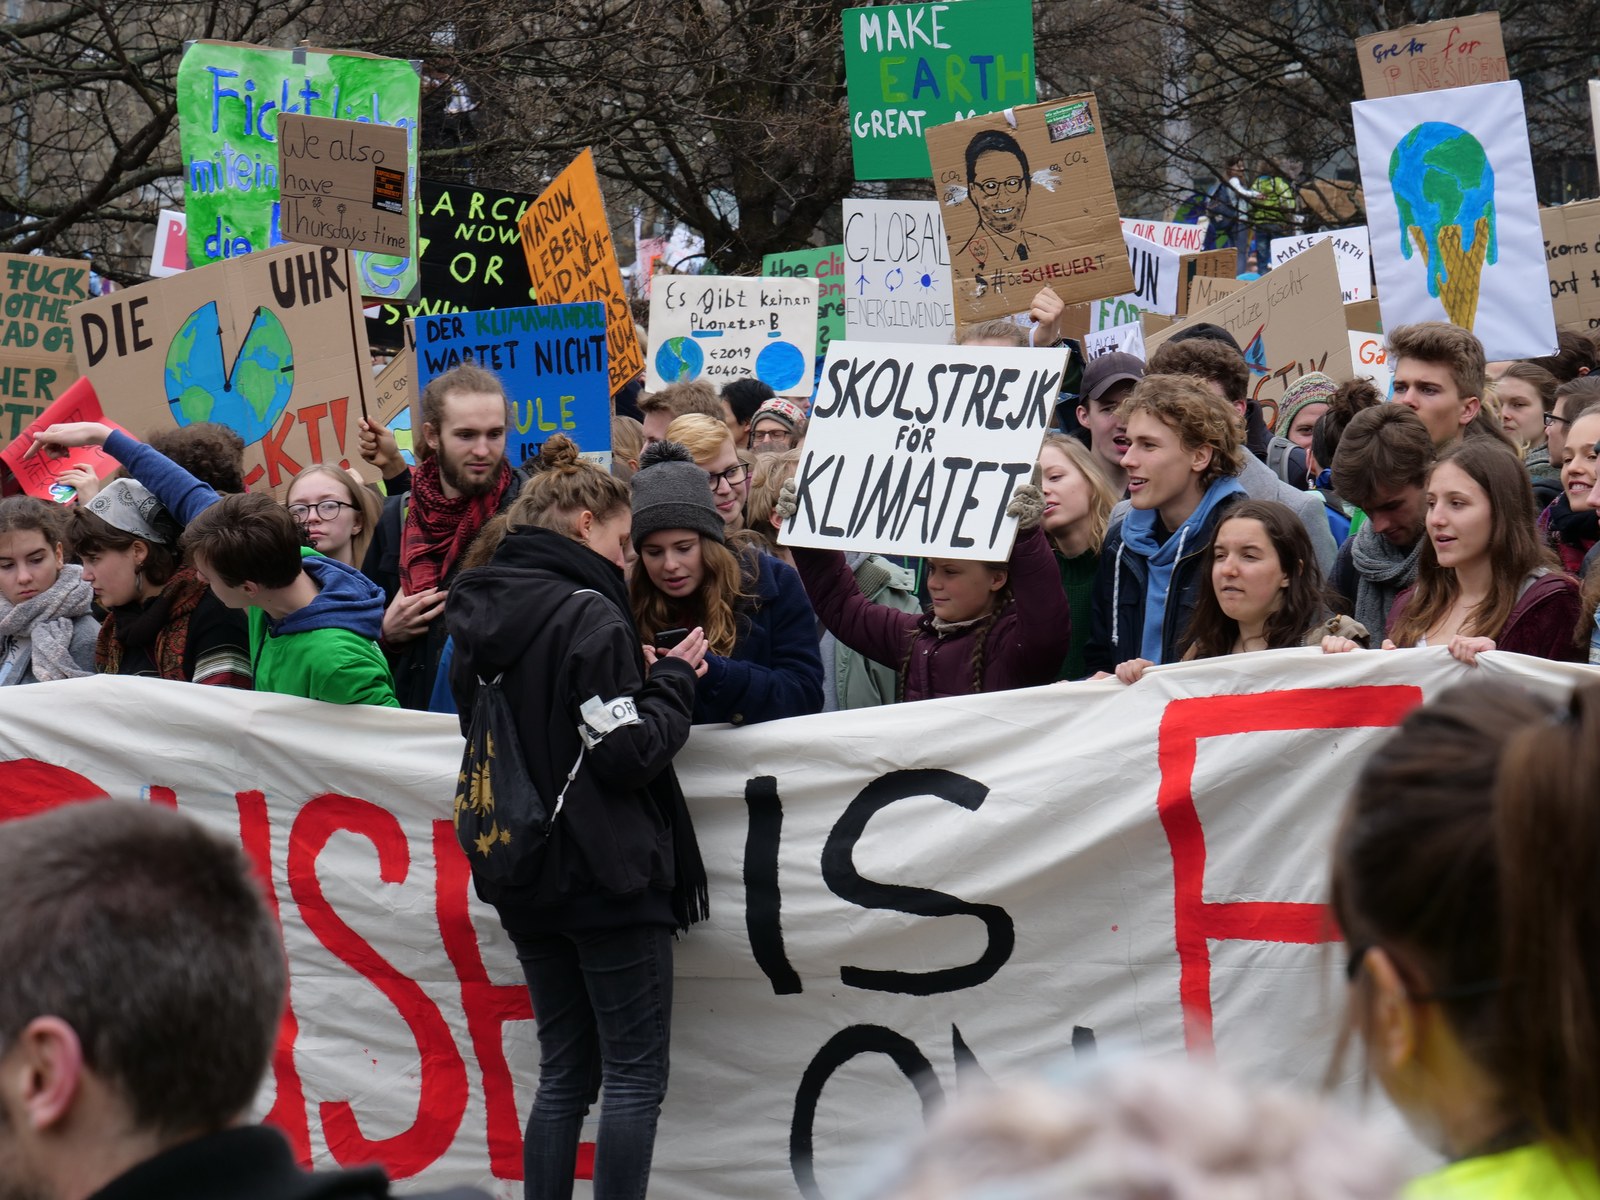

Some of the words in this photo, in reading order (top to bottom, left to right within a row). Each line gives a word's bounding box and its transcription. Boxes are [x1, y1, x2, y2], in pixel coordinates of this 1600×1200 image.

[859, 5, 952, 52] MAKE
[1442, 26, 1482, 58] for
[879, 53, 1030, 104] EARTH
[282, 121, 319, 159] We
[329, 130, 384, 164] also
[854, 109, 926, 138] GREAT
[284, 158, 333, 194] have
[373, 216, 406, 249] time
[521, 179, 576, 254] WARUM
[531, 212, 588, 290] LEBEN
[845, 212, 951, 265] GLOBAL
[1163, 225, 1202, 250] OCEANS
[1277, 236, 1315, 263] MAKE
[1328, 235, 1364, 260] ARTH
[7, 259, 86, 299] FUCK
[270, 246, 348, 309] UHR
[450, 252, 504, 286] OR
[769, 258, 808, 278] the
[1550, 271, 1579, 298] ant
[665, 281, 686, 309] Es
[760, 289, 811, 308] keinen
[81, 297, 153, 367] DIE
[426, 317, 465, 343] DER
[475, 303, 605, 337] KLIMAWANDEL
[769, 312, 779, 331] B
[534, 333, 605, 377] NICHT
[706, 365, 739, 376] 2040
[719, 347, 751, 360] 2019
[815, 357, 1061, 431] SKOLSTREJK
[896, 423, 936, 453] FÖR
[788, 450, 1031, 549] KLIMATET
[745, 768, 1015, 997] IS
